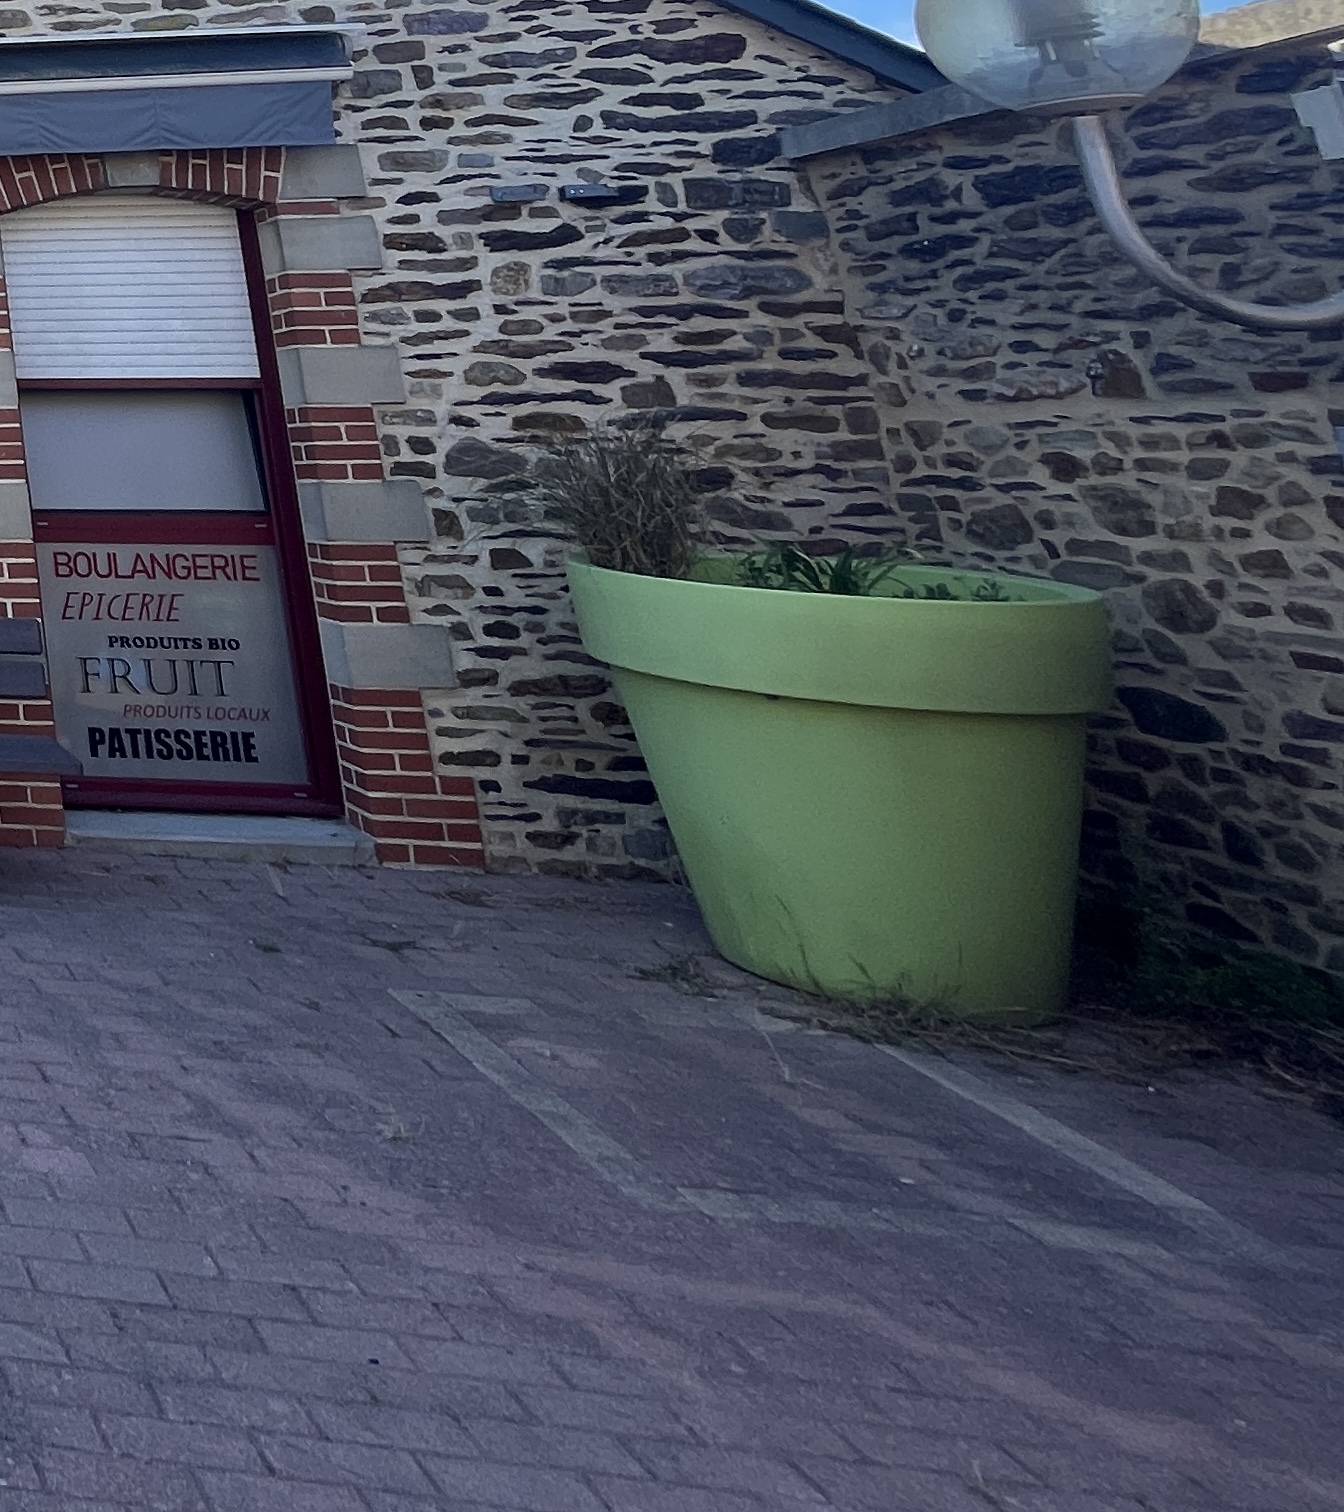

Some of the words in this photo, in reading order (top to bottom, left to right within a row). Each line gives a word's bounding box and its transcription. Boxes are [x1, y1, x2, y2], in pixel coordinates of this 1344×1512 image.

[52, 551, 261, 582] BOULANGERIE
[61, 591, 185, 623] EPICERIE
[107, 635, 203, 651] PRODUITS
[207, 638, 241, 651] BIO
[75, 656, 235, 697] FRUIT
[122, 704, 202, 720] PRODUITS
[206, 706, 271, 721] LOCAUX
[87, 726, 259, 763] PATISSERIE
